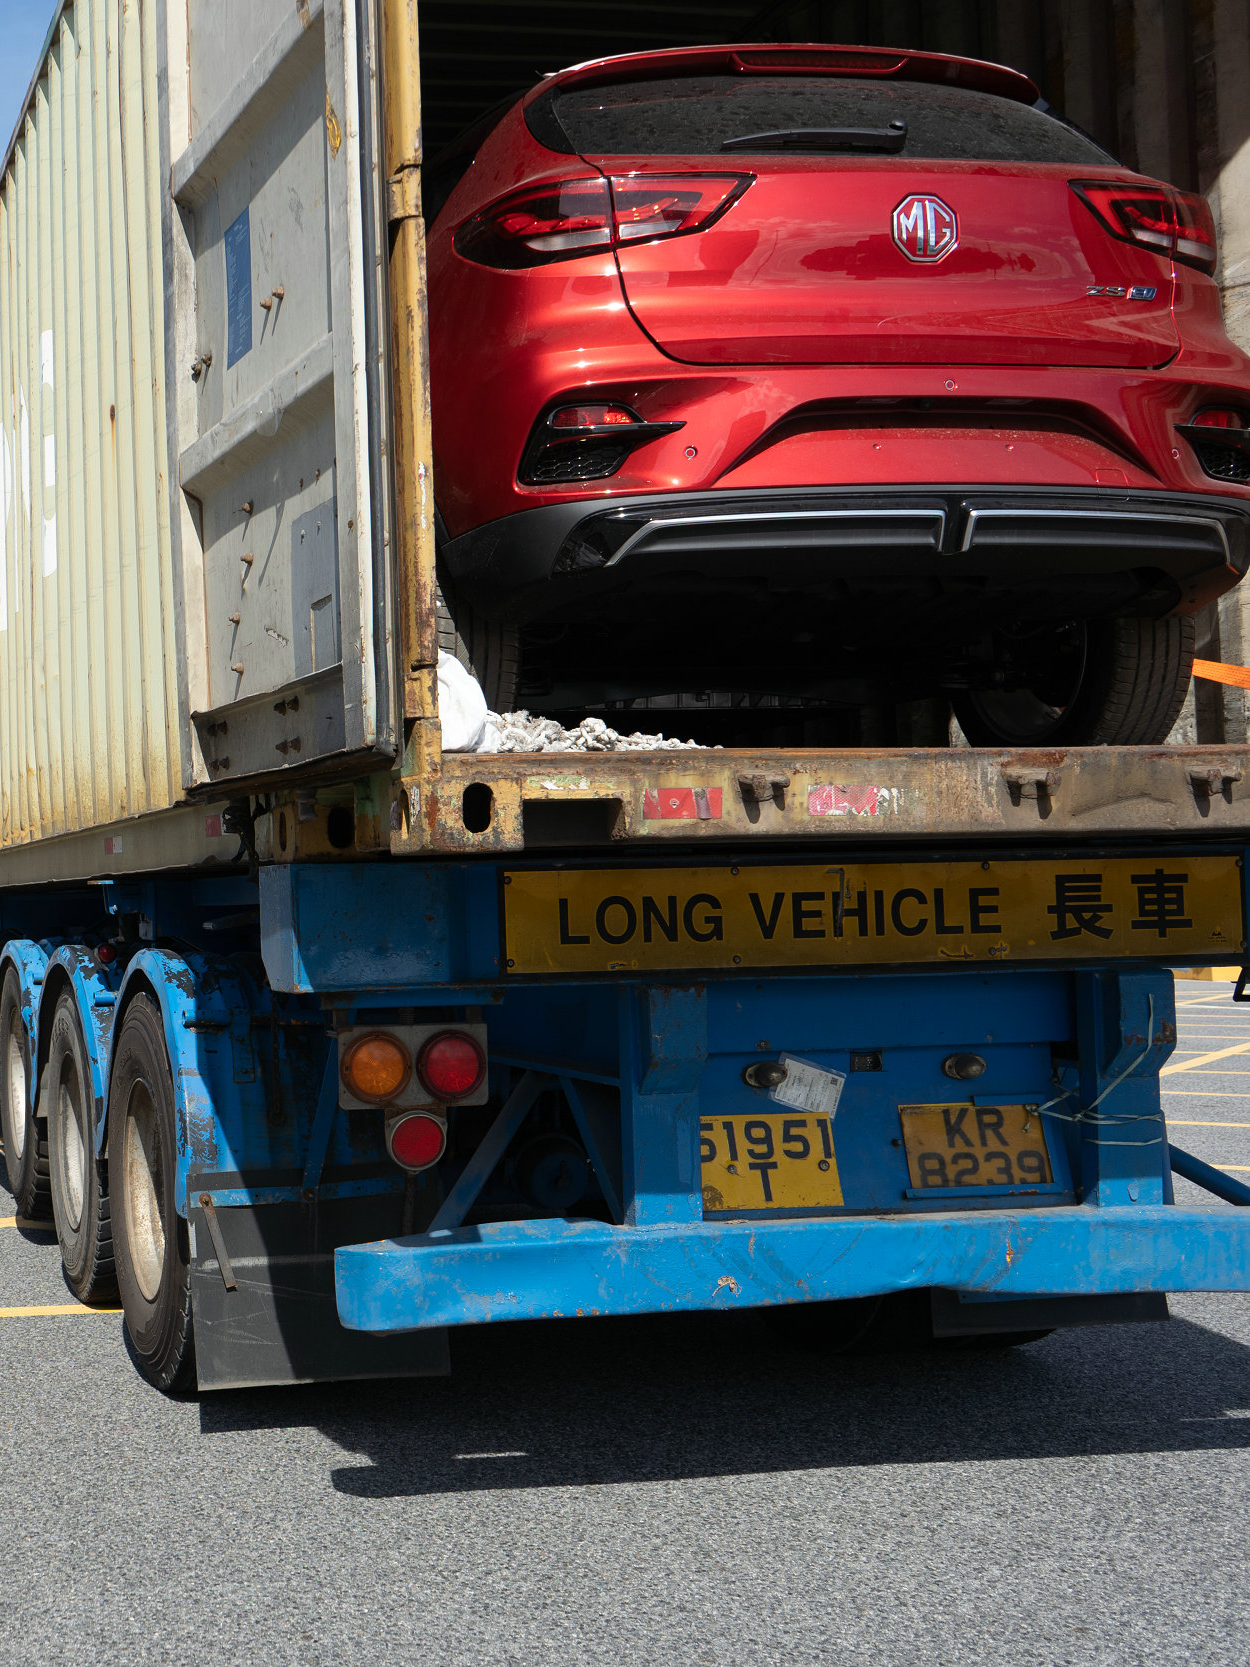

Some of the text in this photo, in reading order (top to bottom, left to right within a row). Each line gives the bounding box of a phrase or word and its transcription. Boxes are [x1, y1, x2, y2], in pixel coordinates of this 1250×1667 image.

[898, 199, 952, 256] MG
[1086, 285, 1126, 297] ZS
[558, 887, 1002, 945] LONG VEHICLE
[1046, 868, 1193, 941] 長車
[941, 1107, 1009, 1149] KR
[748, 1161, 779, 1202] T
[917, 1150, 1048, 1187] 8239
